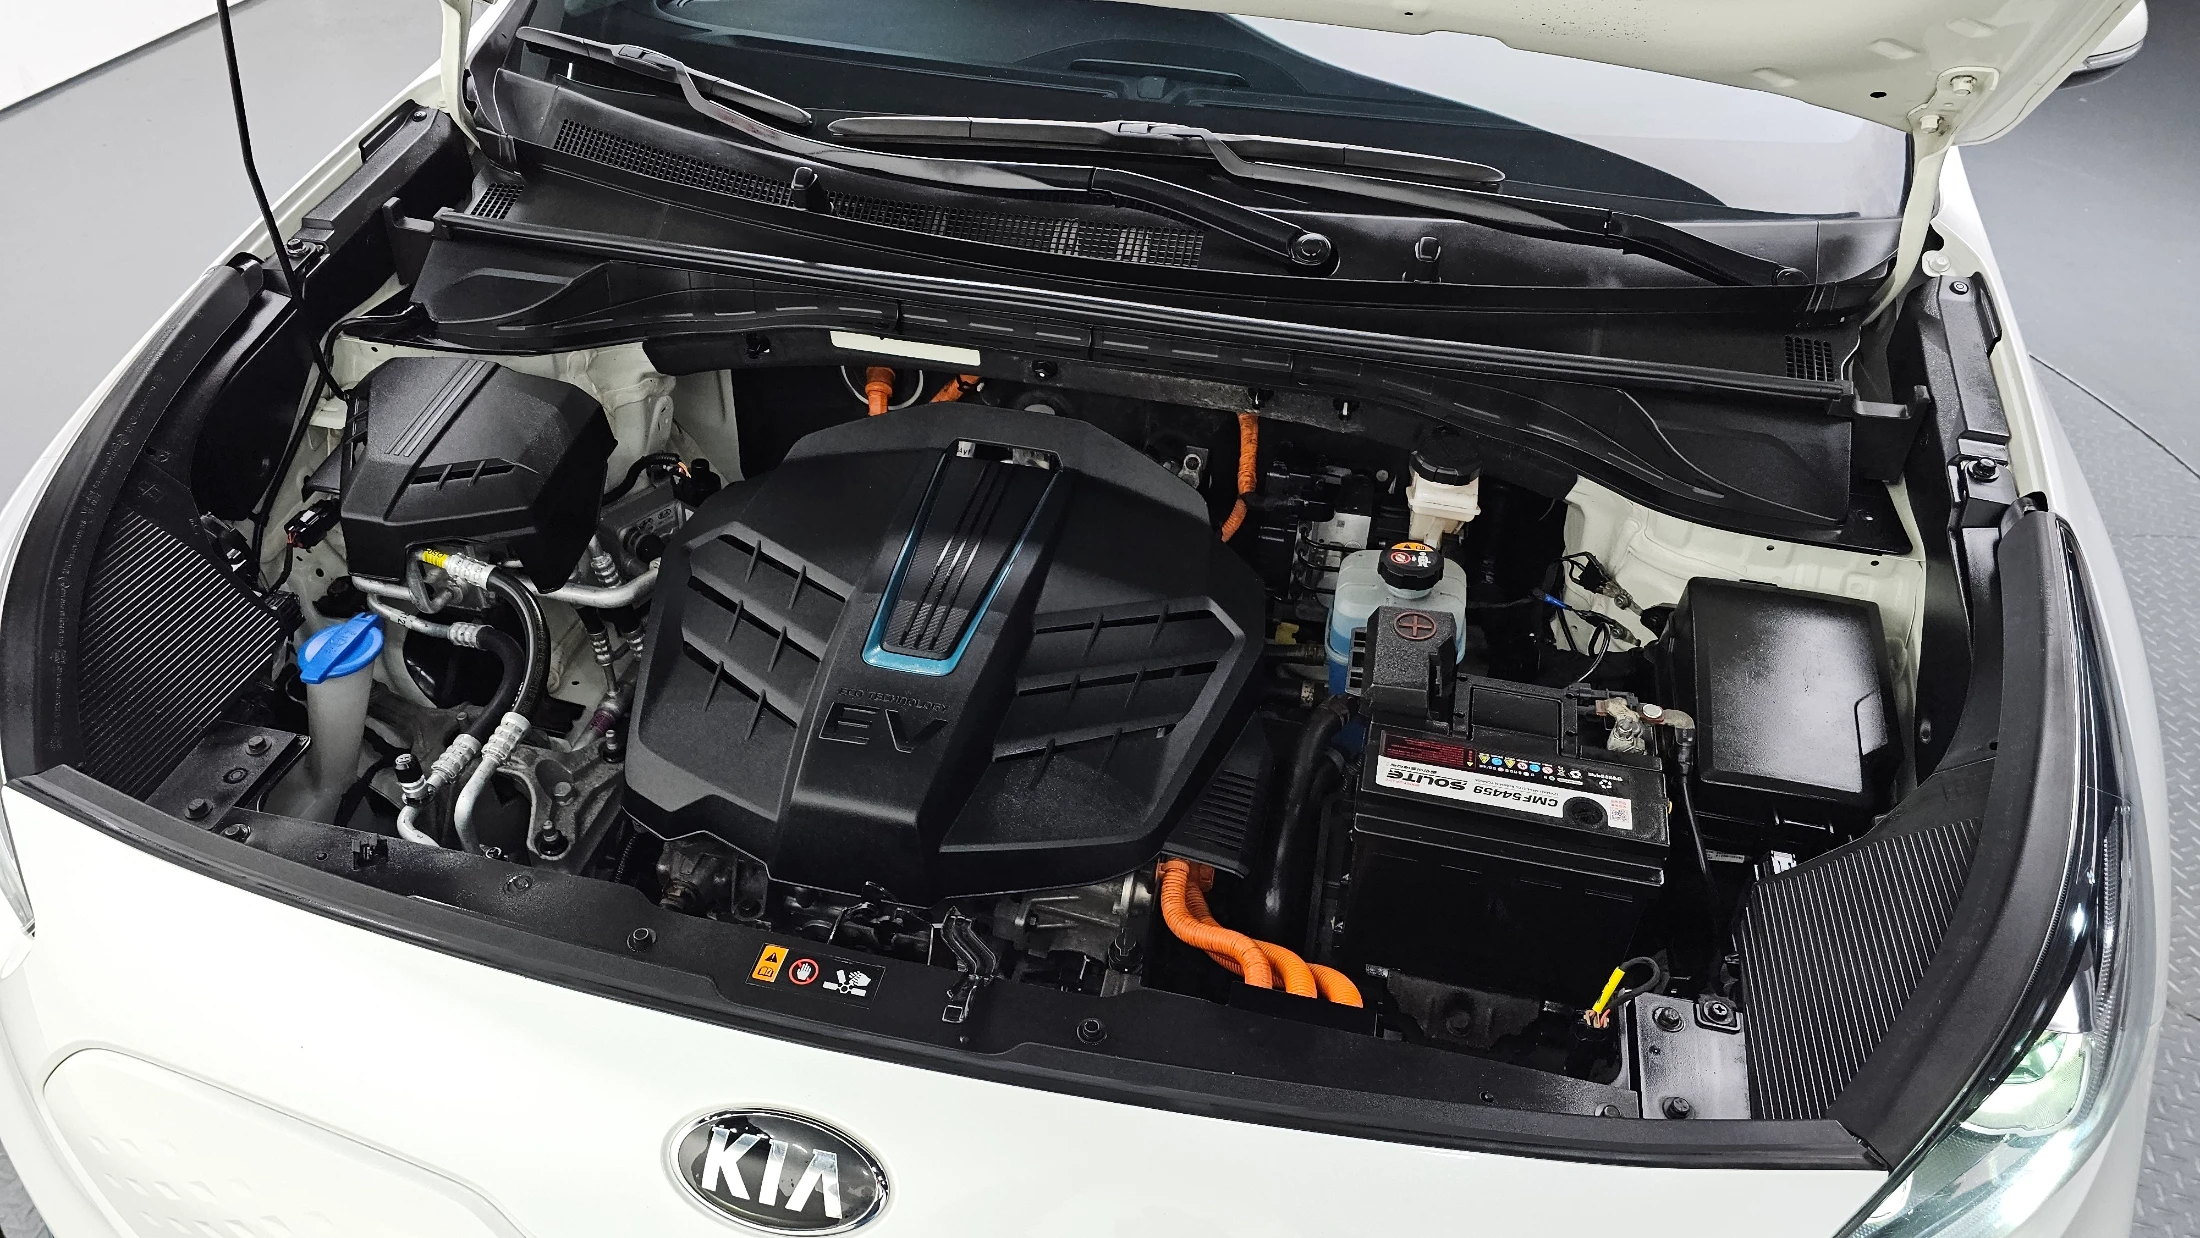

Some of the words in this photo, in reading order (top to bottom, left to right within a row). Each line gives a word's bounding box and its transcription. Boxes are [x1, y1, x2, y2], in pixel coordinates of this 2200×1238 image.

[838, 687, 864, 698] ECO
[868, 691, 949, 713] TECHNOLOGY
[819, 701, 949, 754] EV
[1386, 768, 1469, 791] SOLITE
[1473, 784, 1559, 808] CMF54459
[701, 1126, 842, 1220] KIA
